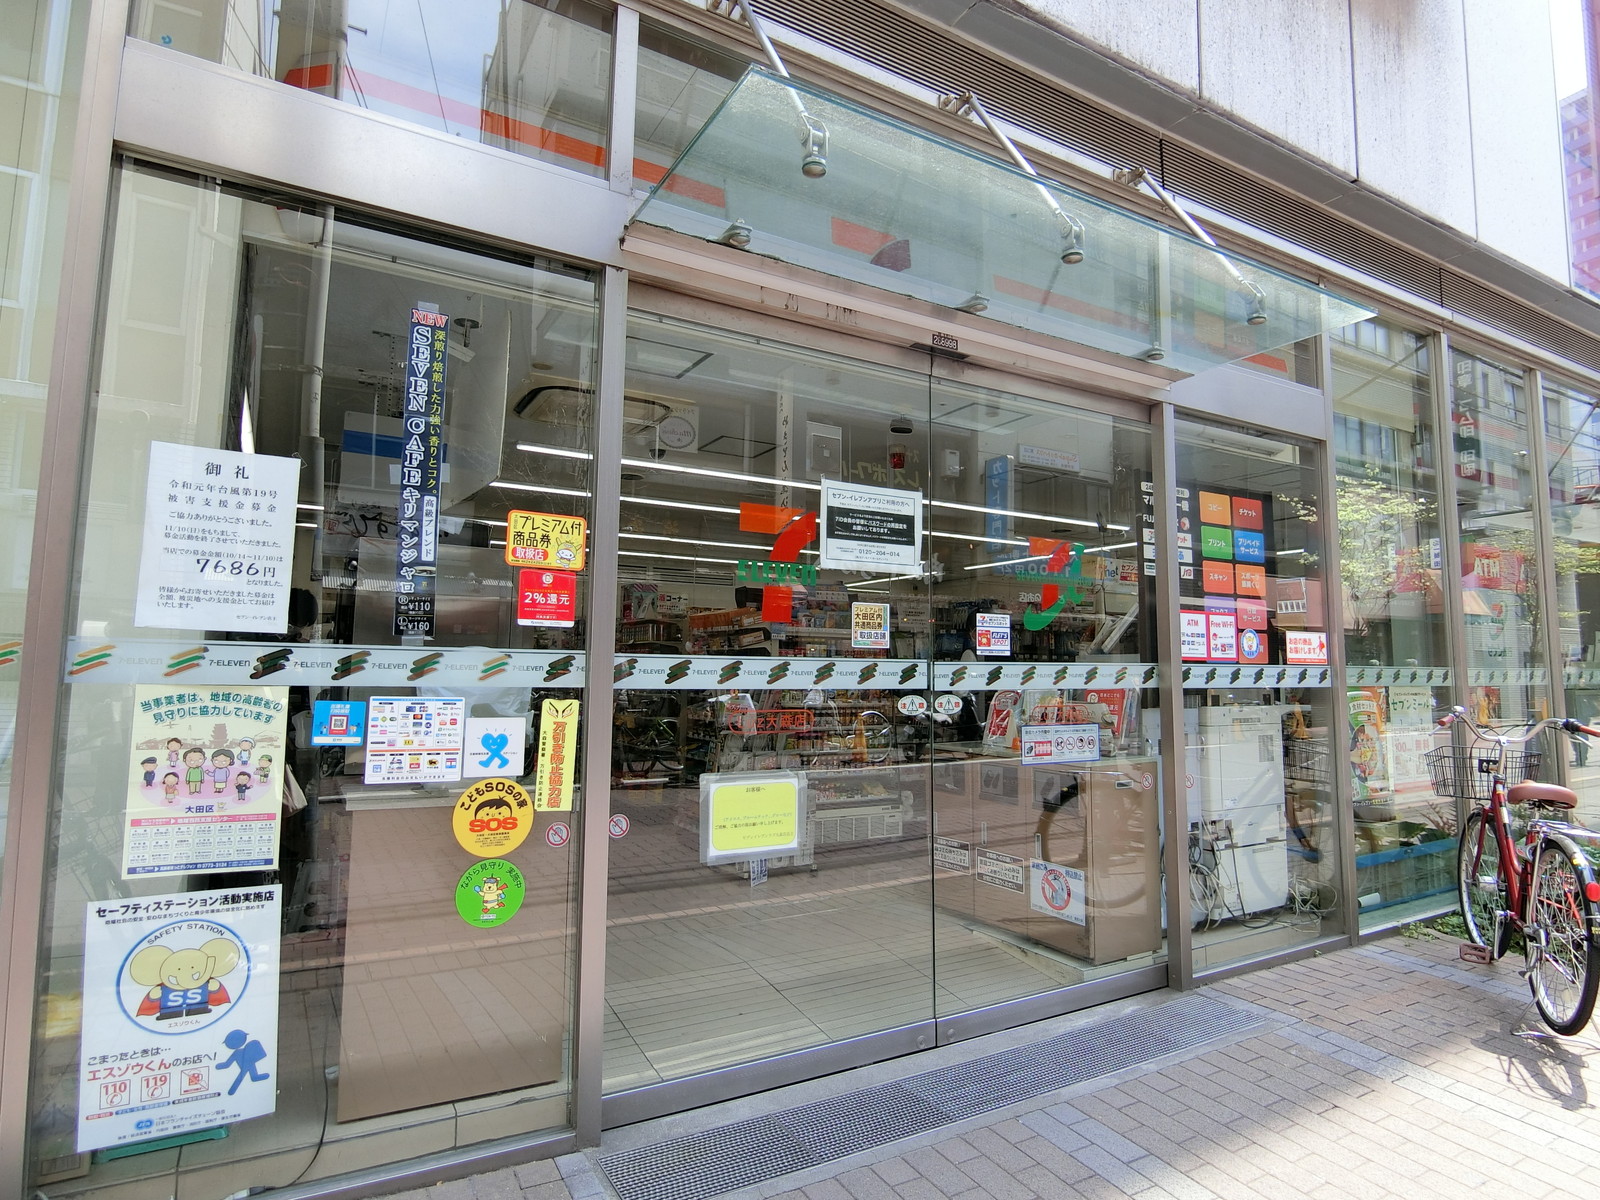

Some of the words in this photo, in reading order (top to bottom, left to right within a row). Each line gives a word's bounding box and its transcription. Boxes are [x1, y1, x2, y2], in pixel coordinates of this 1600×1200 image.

[412, 310, 448, 327] NEW
[408, 326, 432, 412] SEVEN
[403, 418, 426, 486] CAFE
[205, 461, 250, 480] 御礼
[168, 479, 278, 500] 令和元年台風第19号
[167, 493, 277, 513] 被害支援金募金
[1207, 503, 1222, 511] コピー
[1238, 508, 1257, 518] チケット
[168, 511, 273, 528] ご協力ありがとうございました。
[519, 515, 582, 536] プレミアム付
[423, 499, 435, 558] 高級ブレンド
[164, 532, 282, 549] 募金活動を終了させていただきました。
[400, 487, 421, 594] キリマンジャロ
[513, 531, 551, 548] 商品券
[1207, 538, 1226, 547] プリント
[1237, 537, 1260, 547] プリペイド
[515, 546, 544, 561] 取扱店
[1240, 546, 1259, 555] サービス
[1474, 555, 1500, 578] ATM
[246, 579, 284, 588] となりました。
[1208, 572, 1228, 581] スキャン
[157, 601, 195, 610] いたします。
[408, 602, 431, 611] ¥110
[524, 592, 570, 605] 2%還元
[854, 613, 883, 621] 大田区内
[854, 621, 883, 630] 共通商品券
[1186, 619, 1199, 627] ATM
[1210, 619, 1221, 628] Free
[1243, 614, 1262, 623] サービス
[407, 622, 430, 631] ¥160
[859, 631, 887, 640] 取扱店舗
[140, 691, 283, 713] 当事業者は、地域の高齢者の
[1391, 699, 1430, 711] セブンミール
[153, 705, 274, 724] 見守りに協力しています
[547, 721, 567, 809] 万引き防止協力店
[460, 782, 528, 811] こどもSOSの家
[185, 805, 215, 814] 大田区
[469, 816, 518, 833] SOS
[460, 862, 505, 890] ながら見守り
[506, 867, 522, 889] 実施中
[96, 890, 275, 918] セーフティステーション活動実施店
[147, 925, 183, 945] SAFETY
[186, 923, 225, 937] STATION
[168, 1019, 200, 1028] エスゾウくん
[102, 1082, 127, 1095] 110
[143, 1075, 168, 1089] 119
